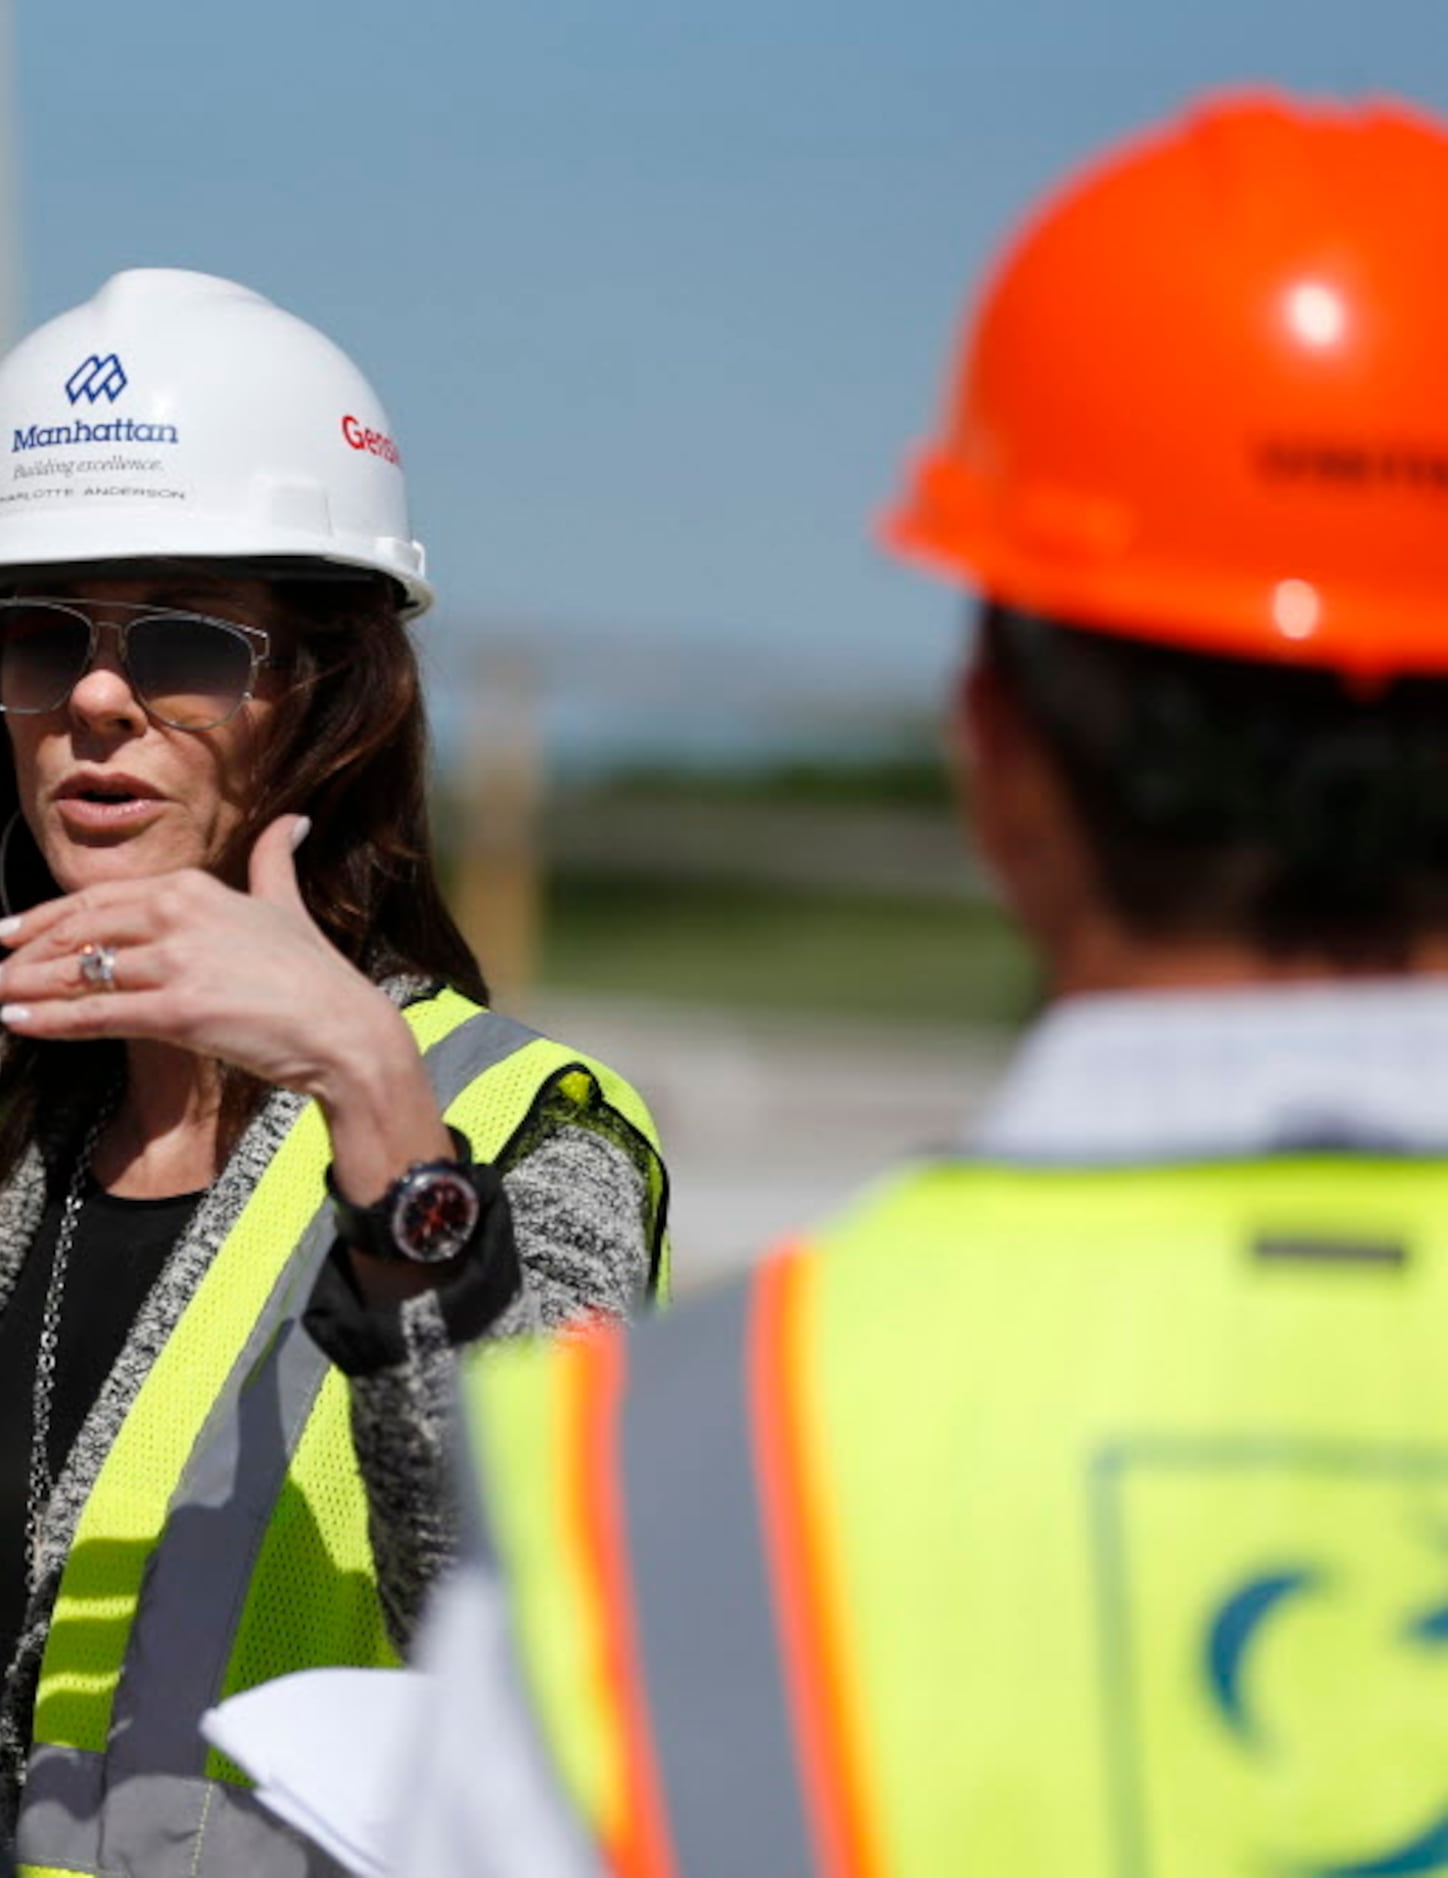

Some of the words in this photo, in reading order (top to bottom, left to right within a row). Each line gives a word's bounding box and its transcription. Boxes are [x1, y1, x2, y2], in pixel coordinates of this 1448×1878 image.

[11, 417, 179, 453] Manhattan
[13, 457, 75, 481] Building
[84, 485, 186, 501] ANDERSON
